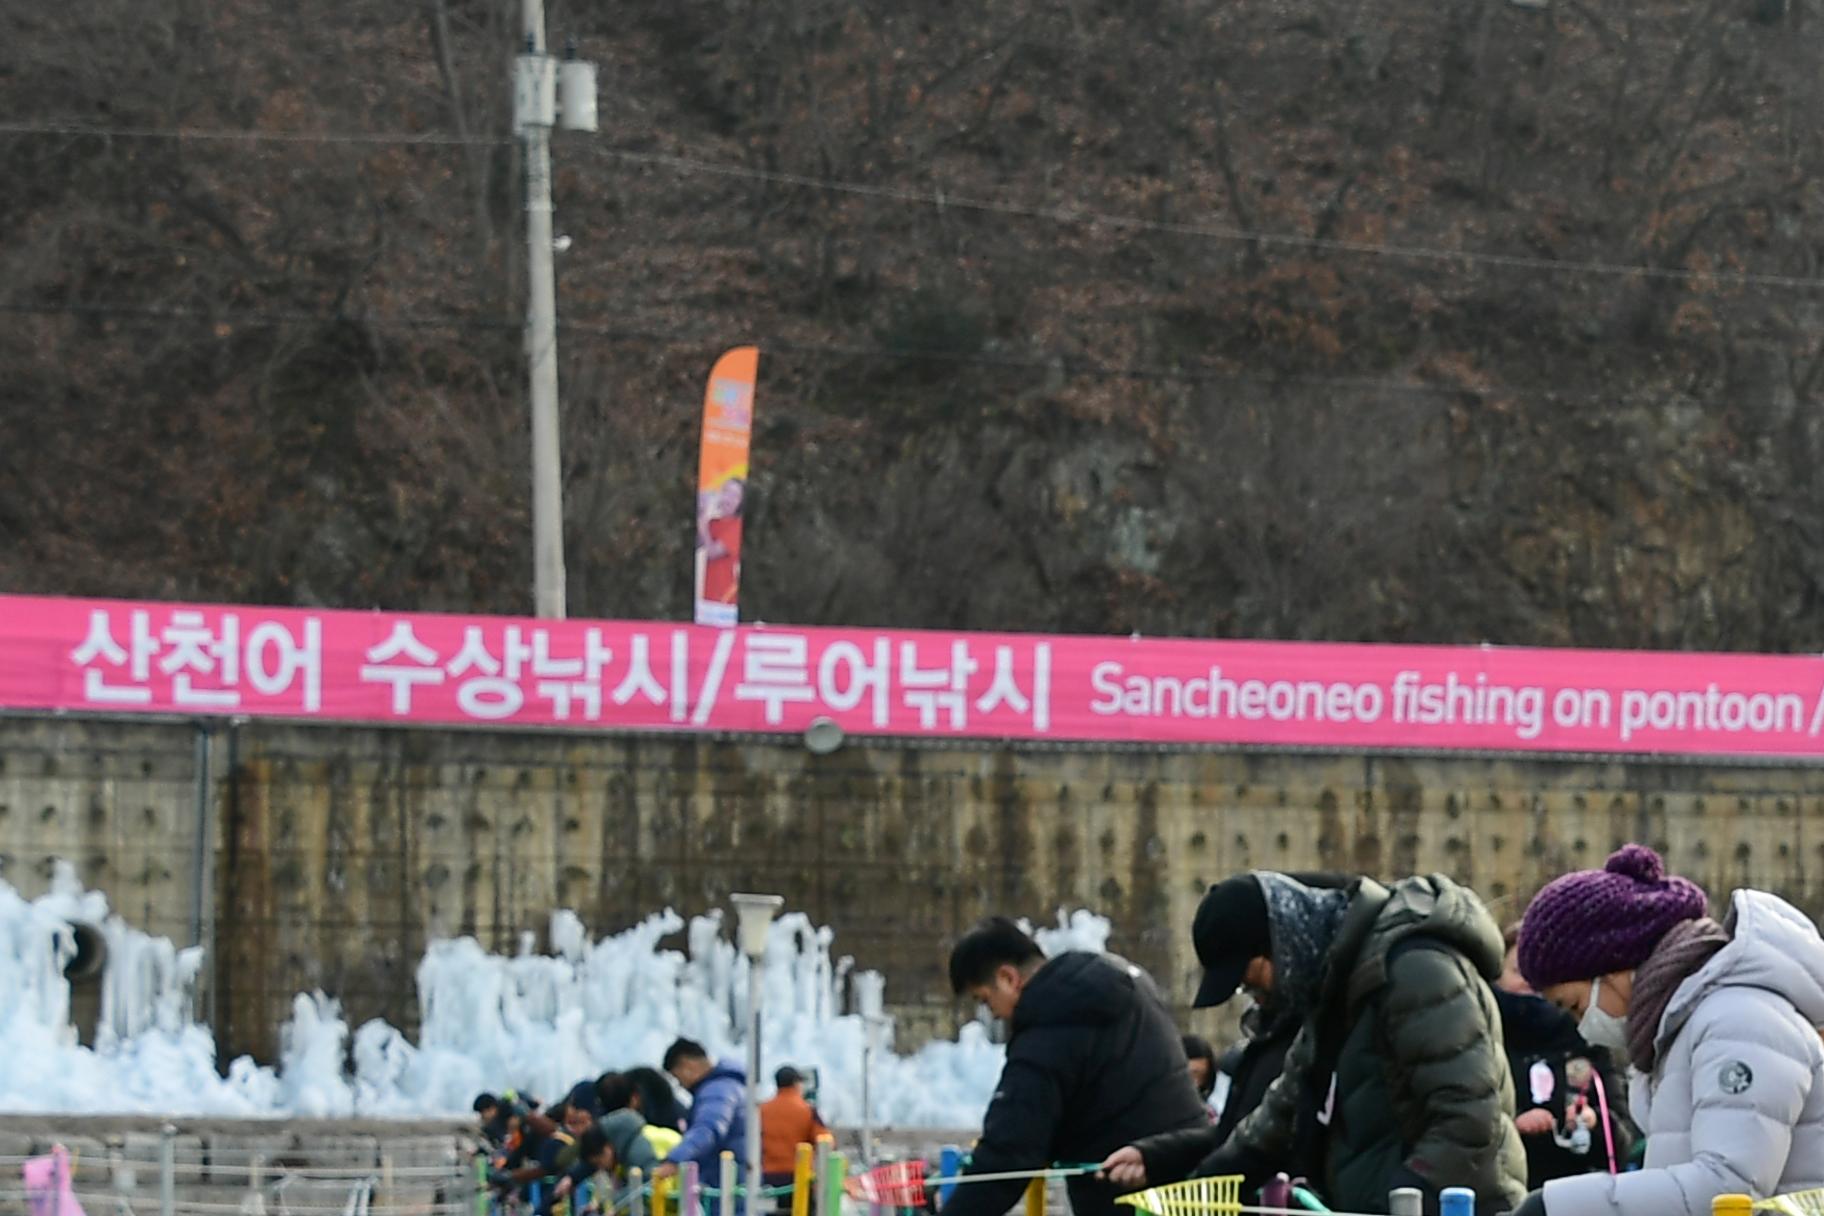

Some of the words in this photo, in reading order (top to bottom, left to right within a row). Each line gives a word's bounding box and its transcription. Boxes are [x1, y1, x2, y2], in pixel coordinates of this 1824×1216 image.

[71, 608, 322, 713] 산천어
[358, 619, 1052, 732] 수상낚시/루어낚시
[1091, 661, 1382, 723] Sancheoneo
[1391, 671, 1545, 739] fishing
[1552, 687, 1612, 729] on
[1620, 683, 1802, 742] pontoon
